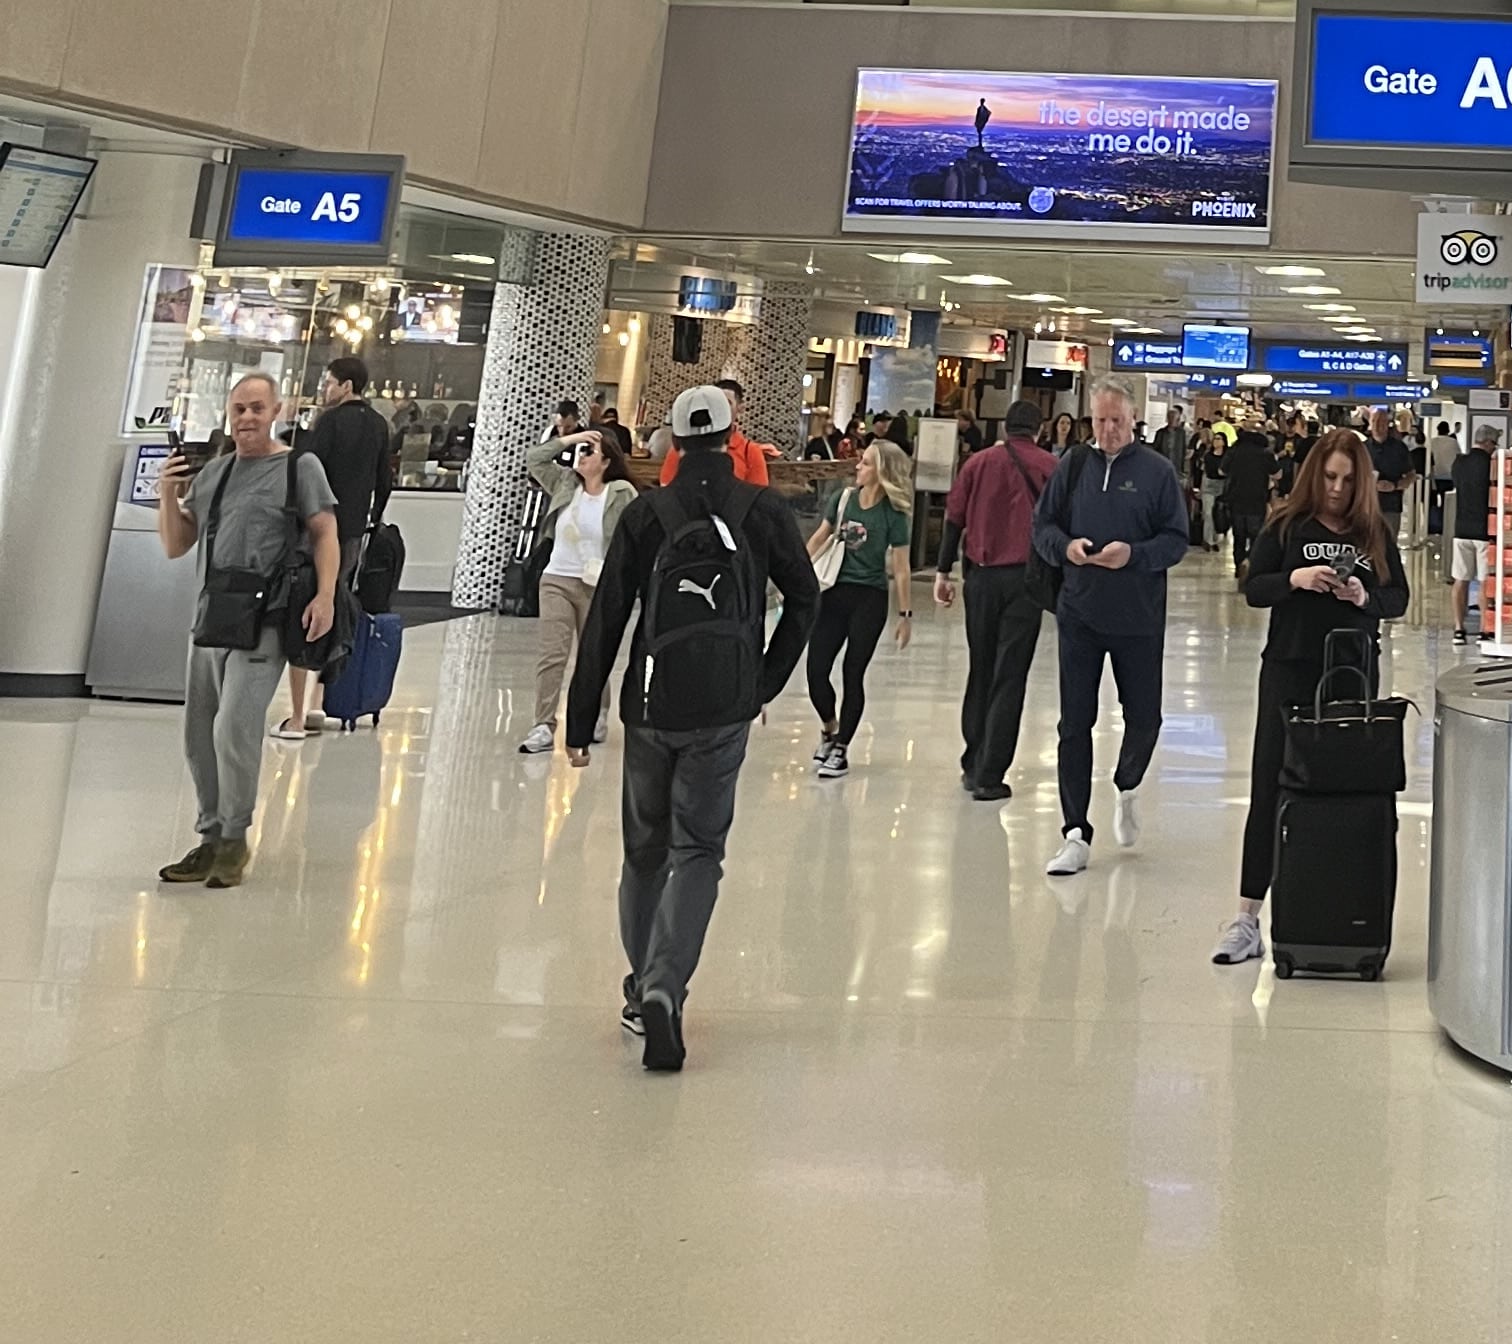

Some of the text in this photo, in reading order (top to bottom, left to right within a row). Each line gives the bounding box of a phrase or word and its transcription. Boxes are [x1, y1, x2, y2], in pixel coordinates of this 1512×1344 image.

[1365, 66, 1436, 94] Gate
[1039, 100, 1250, 131] the desert made
[1088, 128, 1197, 155] me do it.
[262, 193, 360, 222] Gate A5
[855, 197, 874, 205] SCAN
[875, 198, 889, 206] FOR
[890, 198, 913, 207] TRAVEL
[915, 199, 940, 208] OFFERS
[941, 200, 967, 209] WORTH
[968, 201, 996, 210] TALKING
[1192, 201, 1256, 218] PHOENIX
[1424, 272, 1510, 292] tripadvisor
